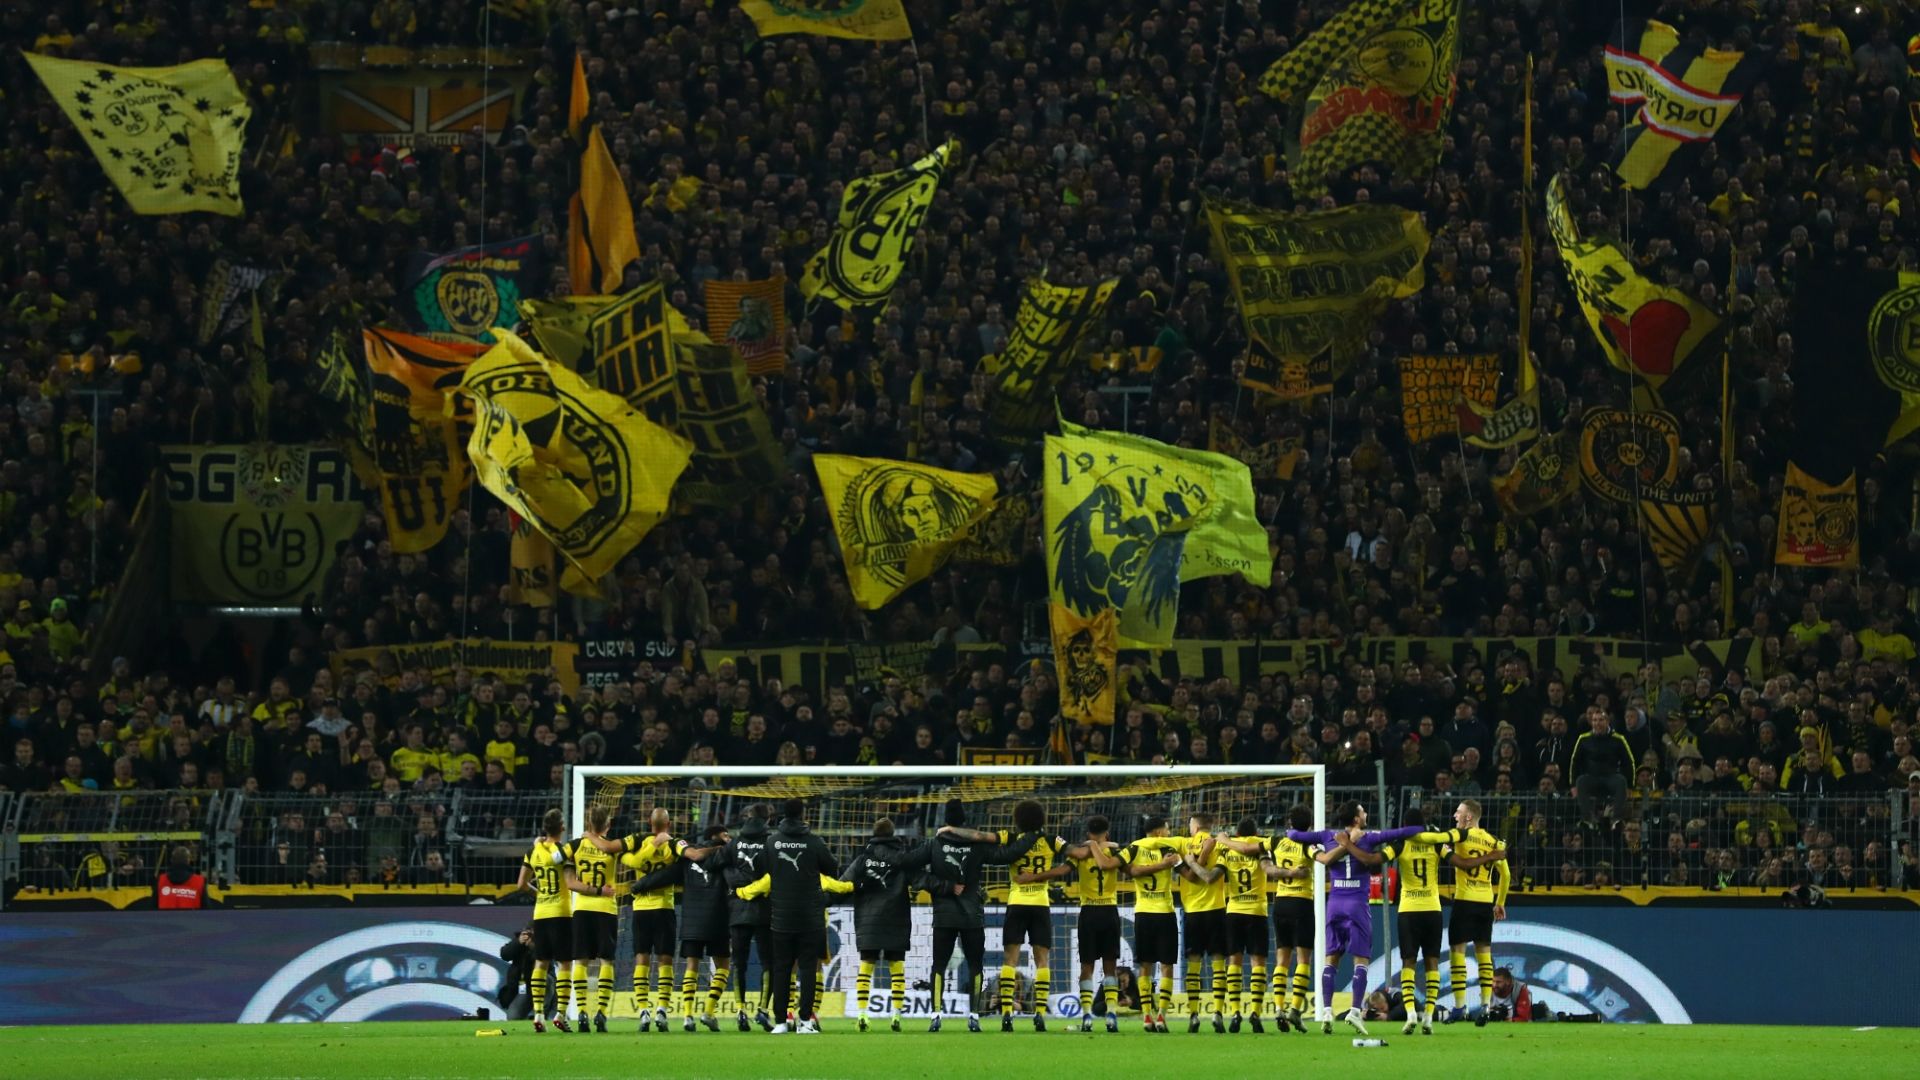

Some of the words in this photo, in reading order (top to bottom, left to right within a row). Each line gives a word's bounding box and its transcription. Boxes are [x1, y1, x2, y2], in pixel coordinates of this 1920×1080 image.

[1640, 486, 1669, 501] THE
[1674, 490, 1717, 503] UNITY
[237, 512, 306, 568] BVB
[256, 569, 287, 588] 09
[578, 860, 607, 889] 26
[1018, 855, 1045, 877] 28
[1339, 855, 1351, 880] 1
[1413, 858, 1427, 888] 4
[535, 866, 560, 895] 20
[1238, 868, 1251, 894] 9
